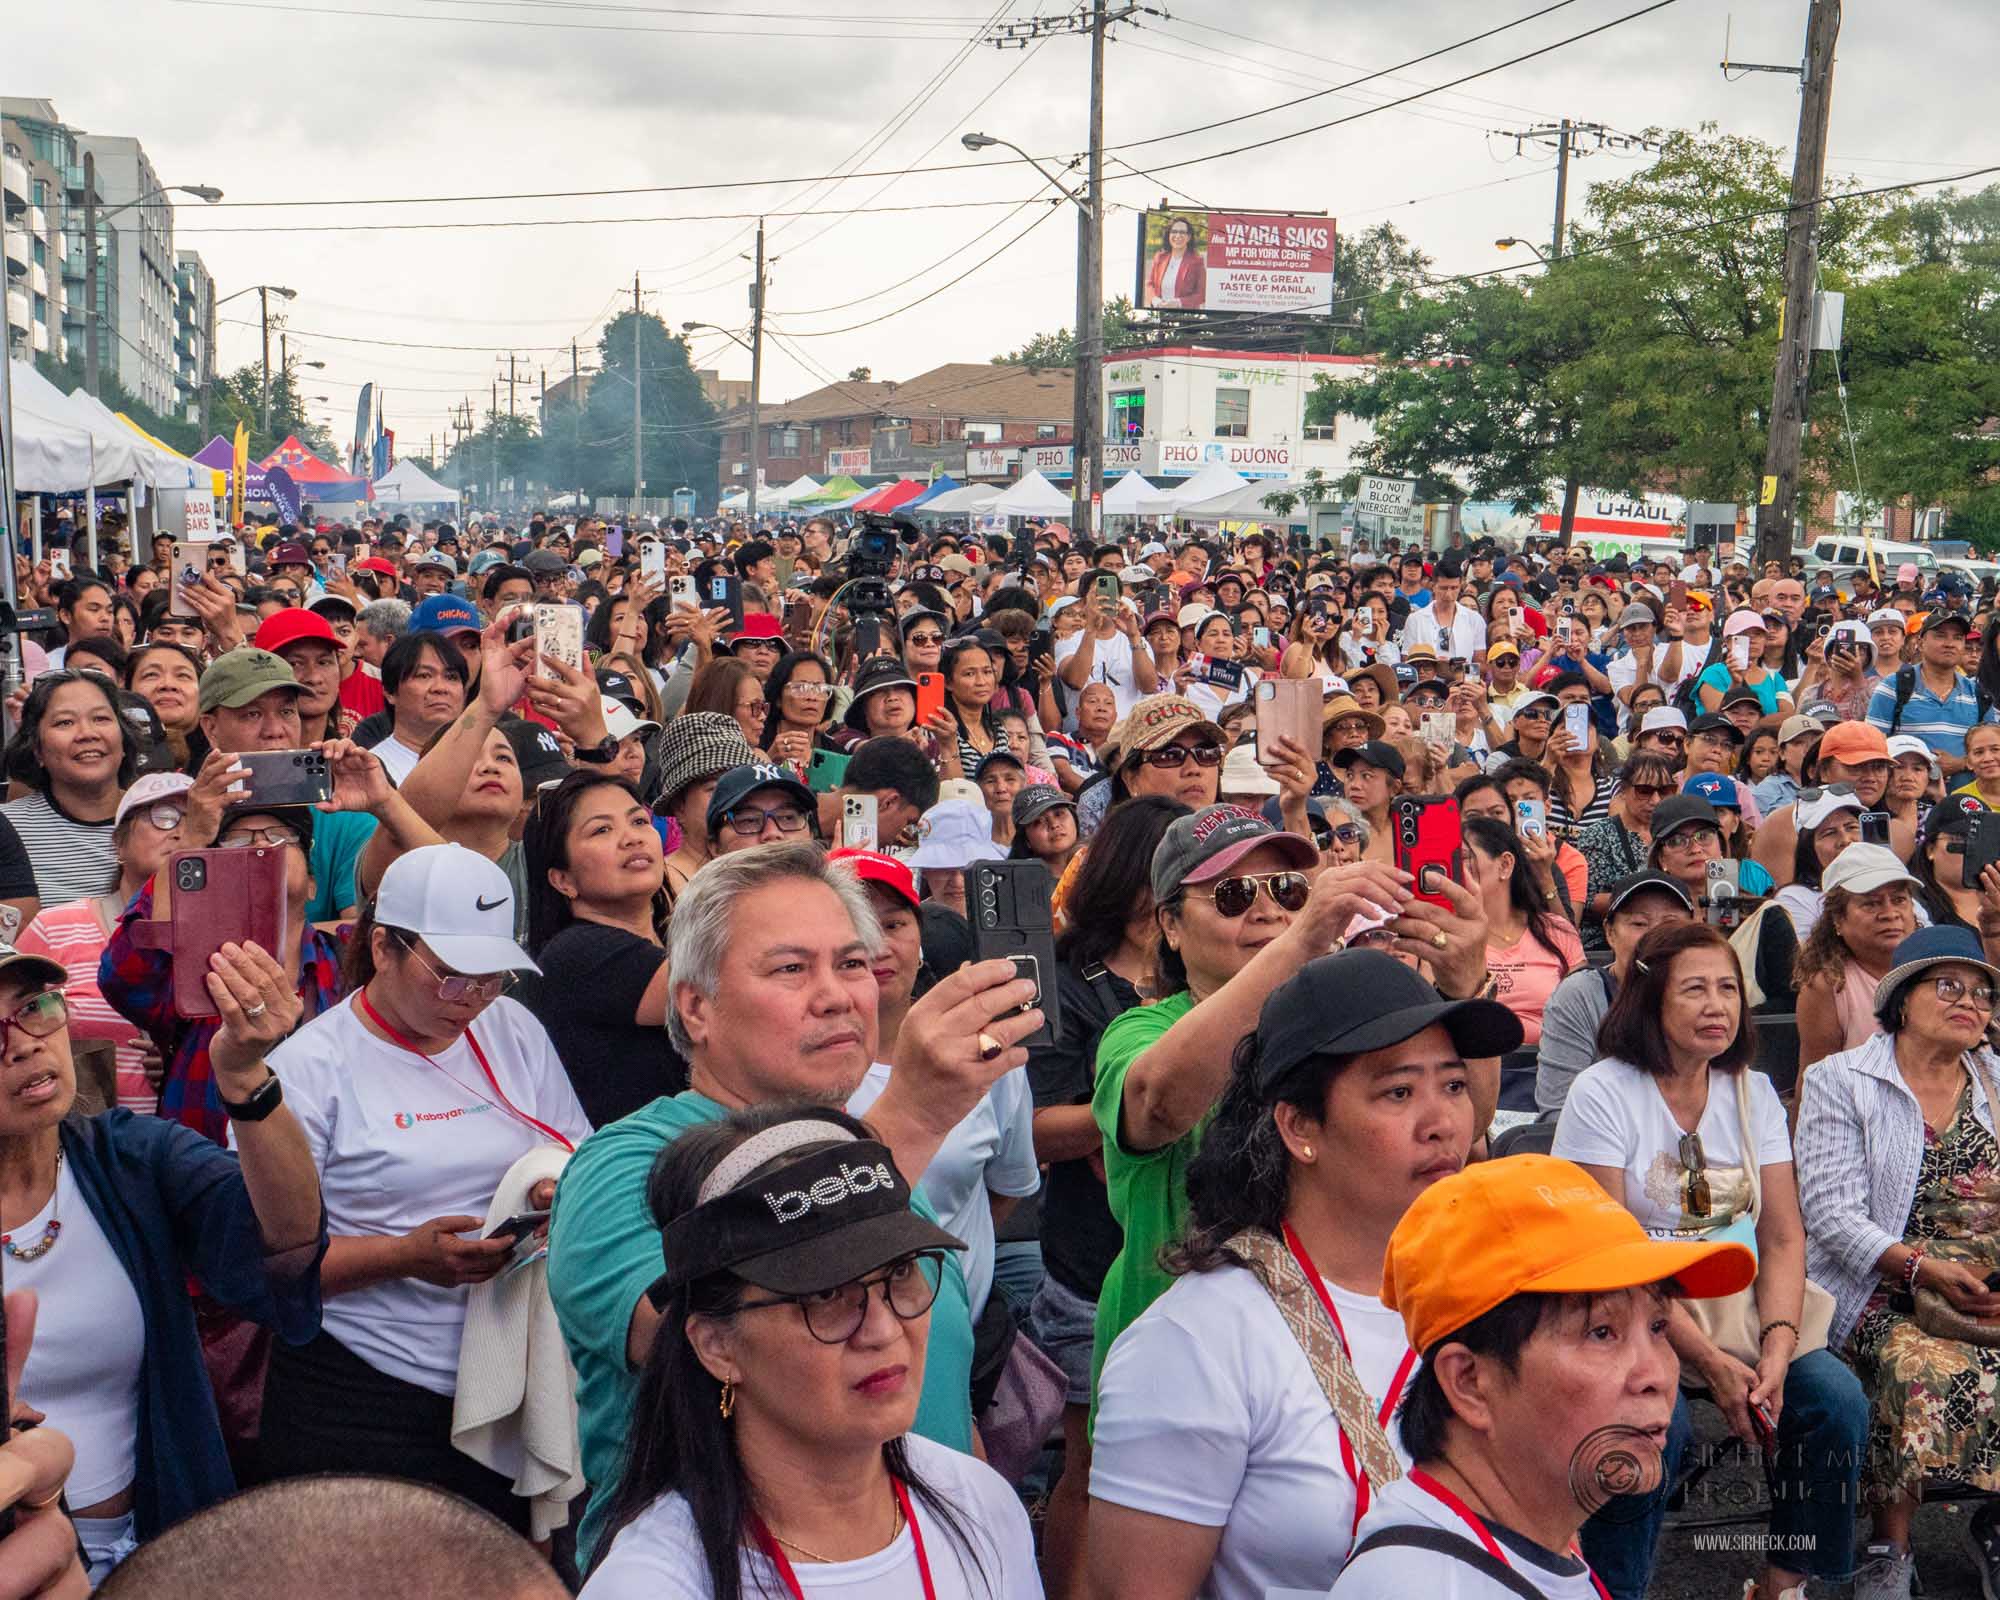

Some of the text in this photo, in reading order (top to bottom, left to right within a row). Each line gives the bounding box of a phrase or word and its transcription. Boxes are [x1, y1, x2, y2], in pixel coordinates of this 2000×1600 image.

[1225, 224, 1280, 246] YA'ARA
[1285, 227, 1328, 249] SAKS
[1225, 247, 1312, 261] MP FOR YORK CENTRE
[1230, 273, 1305, 284] HAVE A GREAT
[1220, 283, 1316, 294] TASTE OF MANILA!
[1120, 364, 1142, 384] VAPE
[1242, 368, 1287, 386] VAPE
[1369, 480, 1406, 493] DO NOT
[1370, 492, 1401, 503] BLOCK
[184, 502, 211, 514] A'ARA
[1358, 501, 1409, 515] INTERSECTION
[1597, 502, 1672, 520] U-HAUL
[186, 518, 209, 530] SAKS
[437, 609, 471, 620] CHICAGO
[752, 764, 782, 780] NY
[1192, 807, 1229, 846] NEW
